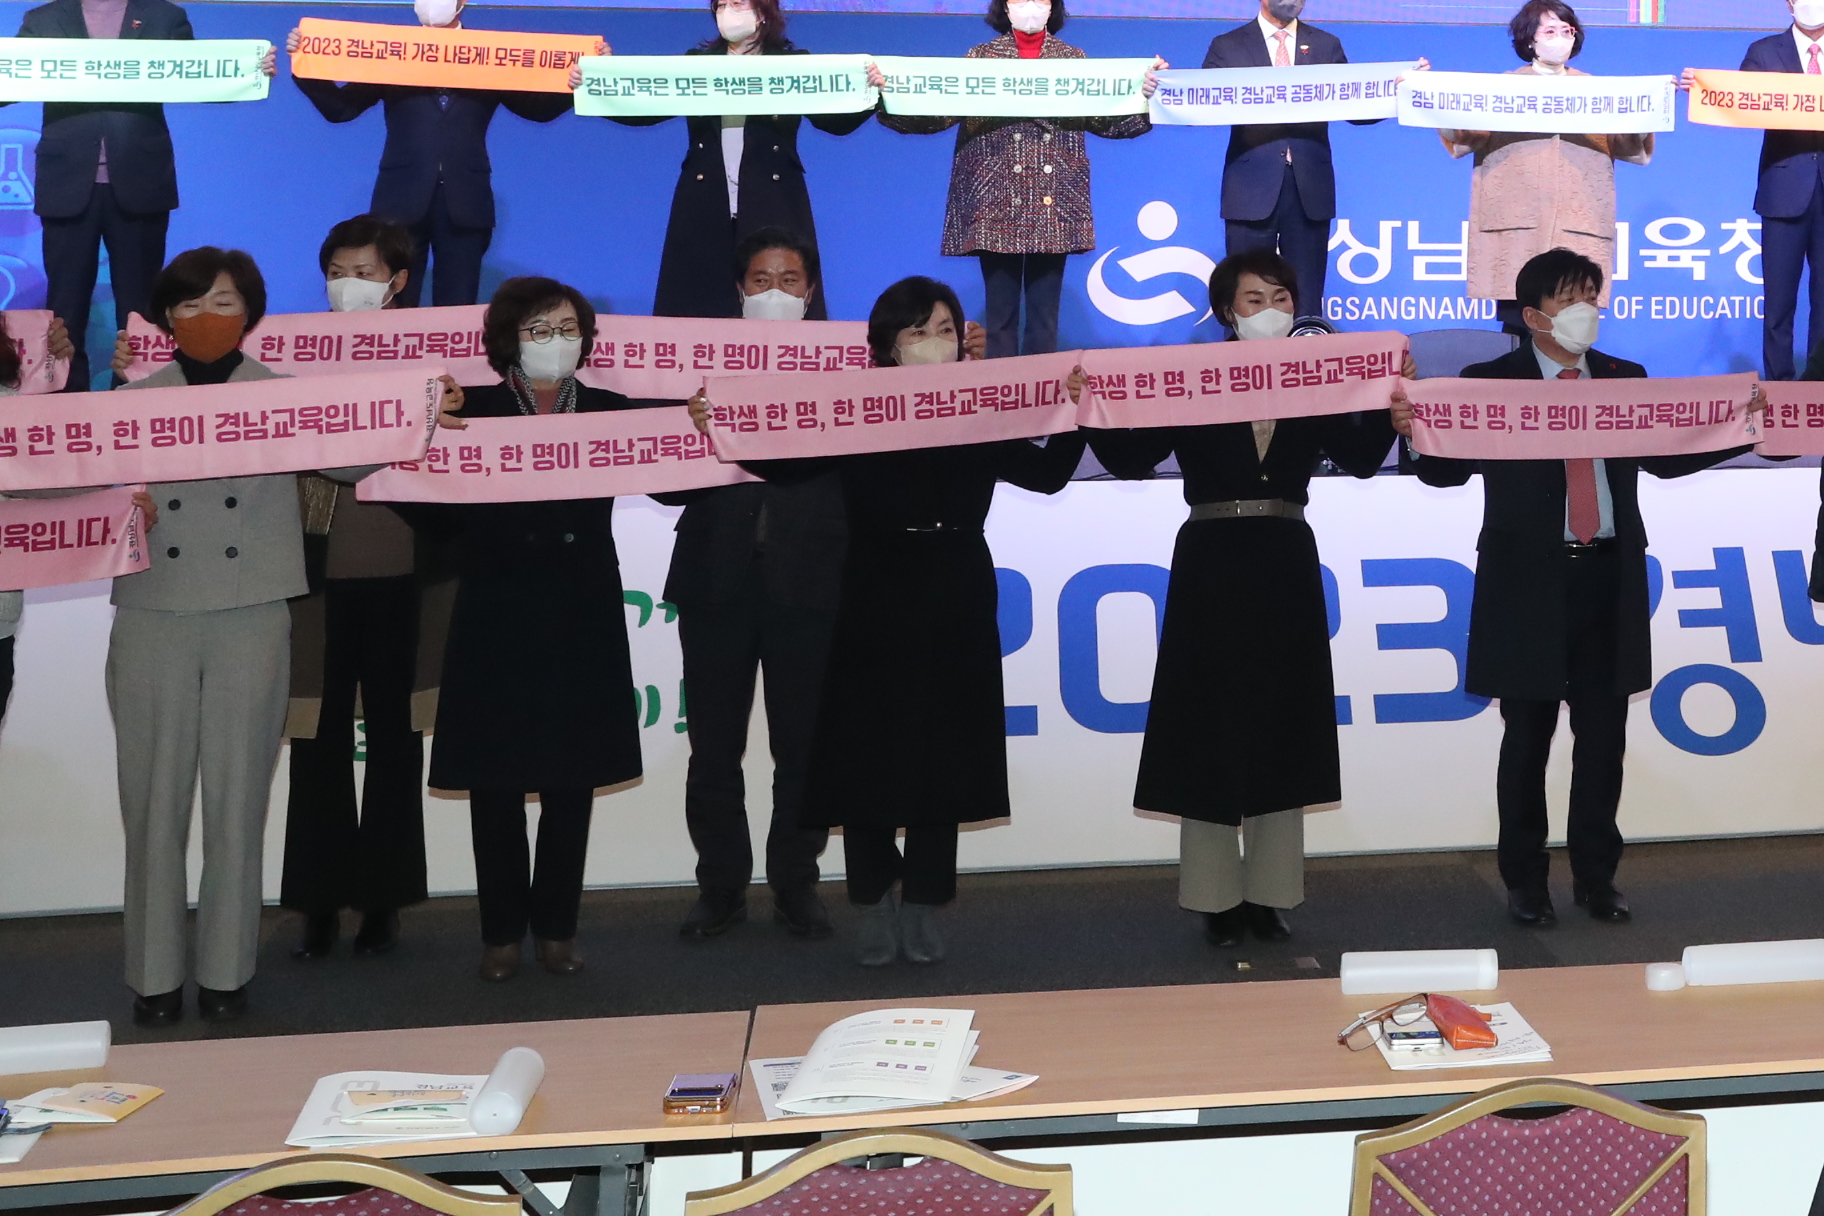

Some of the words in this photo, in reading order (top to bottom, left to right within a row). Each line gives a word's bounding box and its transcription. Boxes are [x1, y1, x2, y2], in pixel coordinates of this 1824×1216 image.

[302, 36, 342, 57] 2023
[346, 38, 407, 61] 경남교육!
[412, 43, 440, 63] 가장
[443, 44, 490, 66] 나답게!
[494, 47, 535, 69] 모두를
[585, 77, 669, 97] 경남교육은
[675, 78, 708, 96] 모든
[713, 76, 763, 95] 학생을
[768, 74, 856, 94] 챙겨갑니다.
[965, 77, 996, 96] 모든
[1002, 77, 1049, 96] 학생을
[1054, 78, 1136, 97] 챙겨갑니다.
[1700, 88, 1734, 108] 2023
[1322, 295, 1497, 321] GSANGNAMD
[1613, 297, 1643, 320] OF
[1134, 372, 1156, 400] 한
[1164, 370, 1193, 401] 명,
[1200, 367, 1222, 395] 한
[1229, 363, 1272, 393] 명이
[712, 404, 760, 433] 학생
[765, 402, 788, 432] 한
[795, 401, 826, 433] 명,
[833, 398, 855, 427] 한
[862, 394, 906, 424] 명이
[913, 379, 1066, 420] 경남교육입니다.
[1413, 402, 1452, 430] 학생
[1459, 403, 1480, 430] 한
[1486, 404, 1513, 434] 명,
[1520, 405, 1540, 431] 한
[1547, 404, 1587, 431] 명이
[1594, 400, 1736, 430] 경남교육입니다.
[1781, 403, 1800, 428] 한
[28, 425, 55, 454] 한
[65, 423, 102, 456] 명,
[112, 420, 140, 451] 한
[150, 414, 205, 447] 명이
[214, 398, 412, 442] 경남교육입니다.
[426, 447, 450, 474] 한
[459, 446, 491, 477] 명,
[500, 445, 524, 473] 한
[532, 441, 579, 472] 명이
[0, 515, 117, 554] 육입니다.
